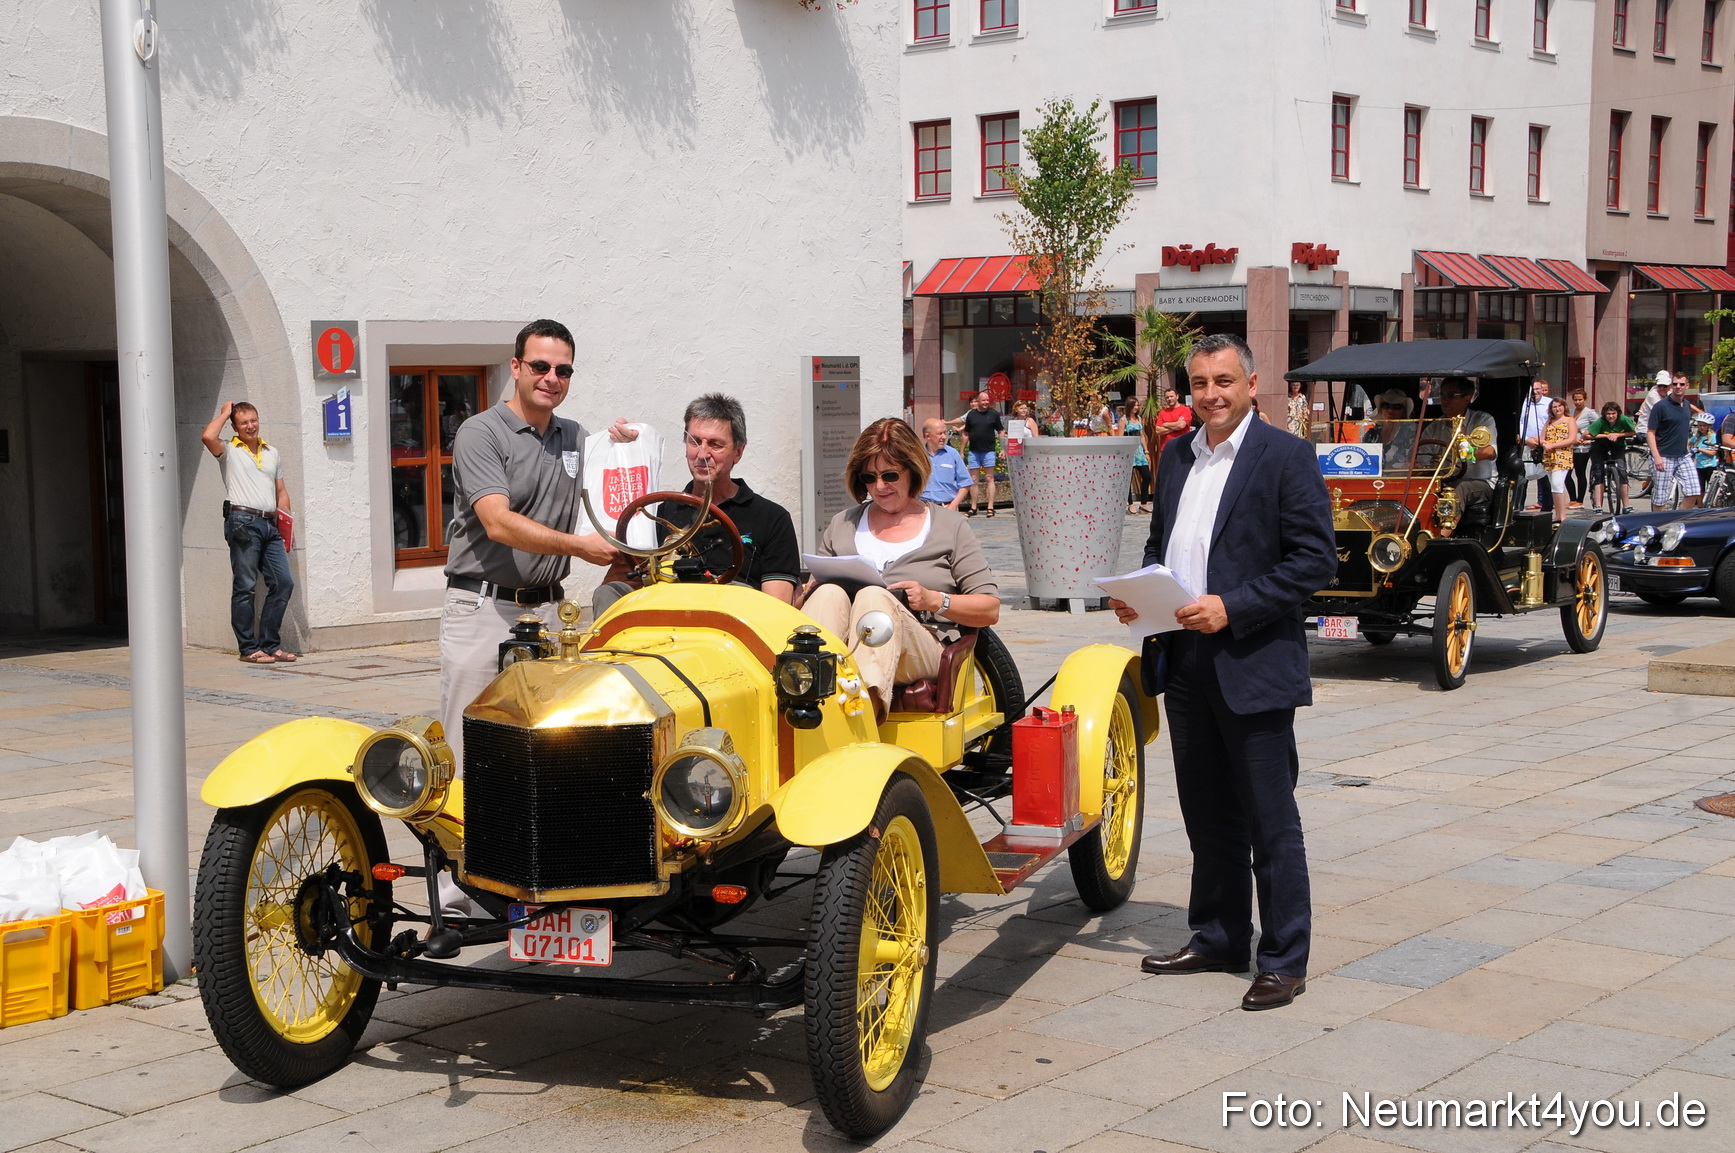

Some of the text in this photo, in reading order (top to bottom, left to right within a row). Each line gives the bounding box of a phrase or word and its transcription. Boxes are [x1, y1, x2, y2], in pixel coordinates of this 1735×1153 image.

[1161, 242, 1239, 272] Döpfer
[1291, 242, 1339, 271] Döpfer
[1159, 294, 1239, 305] BABY & KINDERMODEN
[1345, 454, 1352, 464] 2
[1324, 618, 1342, 628] BAR
[1325, 628, 1348, 637] 0731
[526, 908, 571, 933] DAH
[523, 934, 596, 961] 07101
